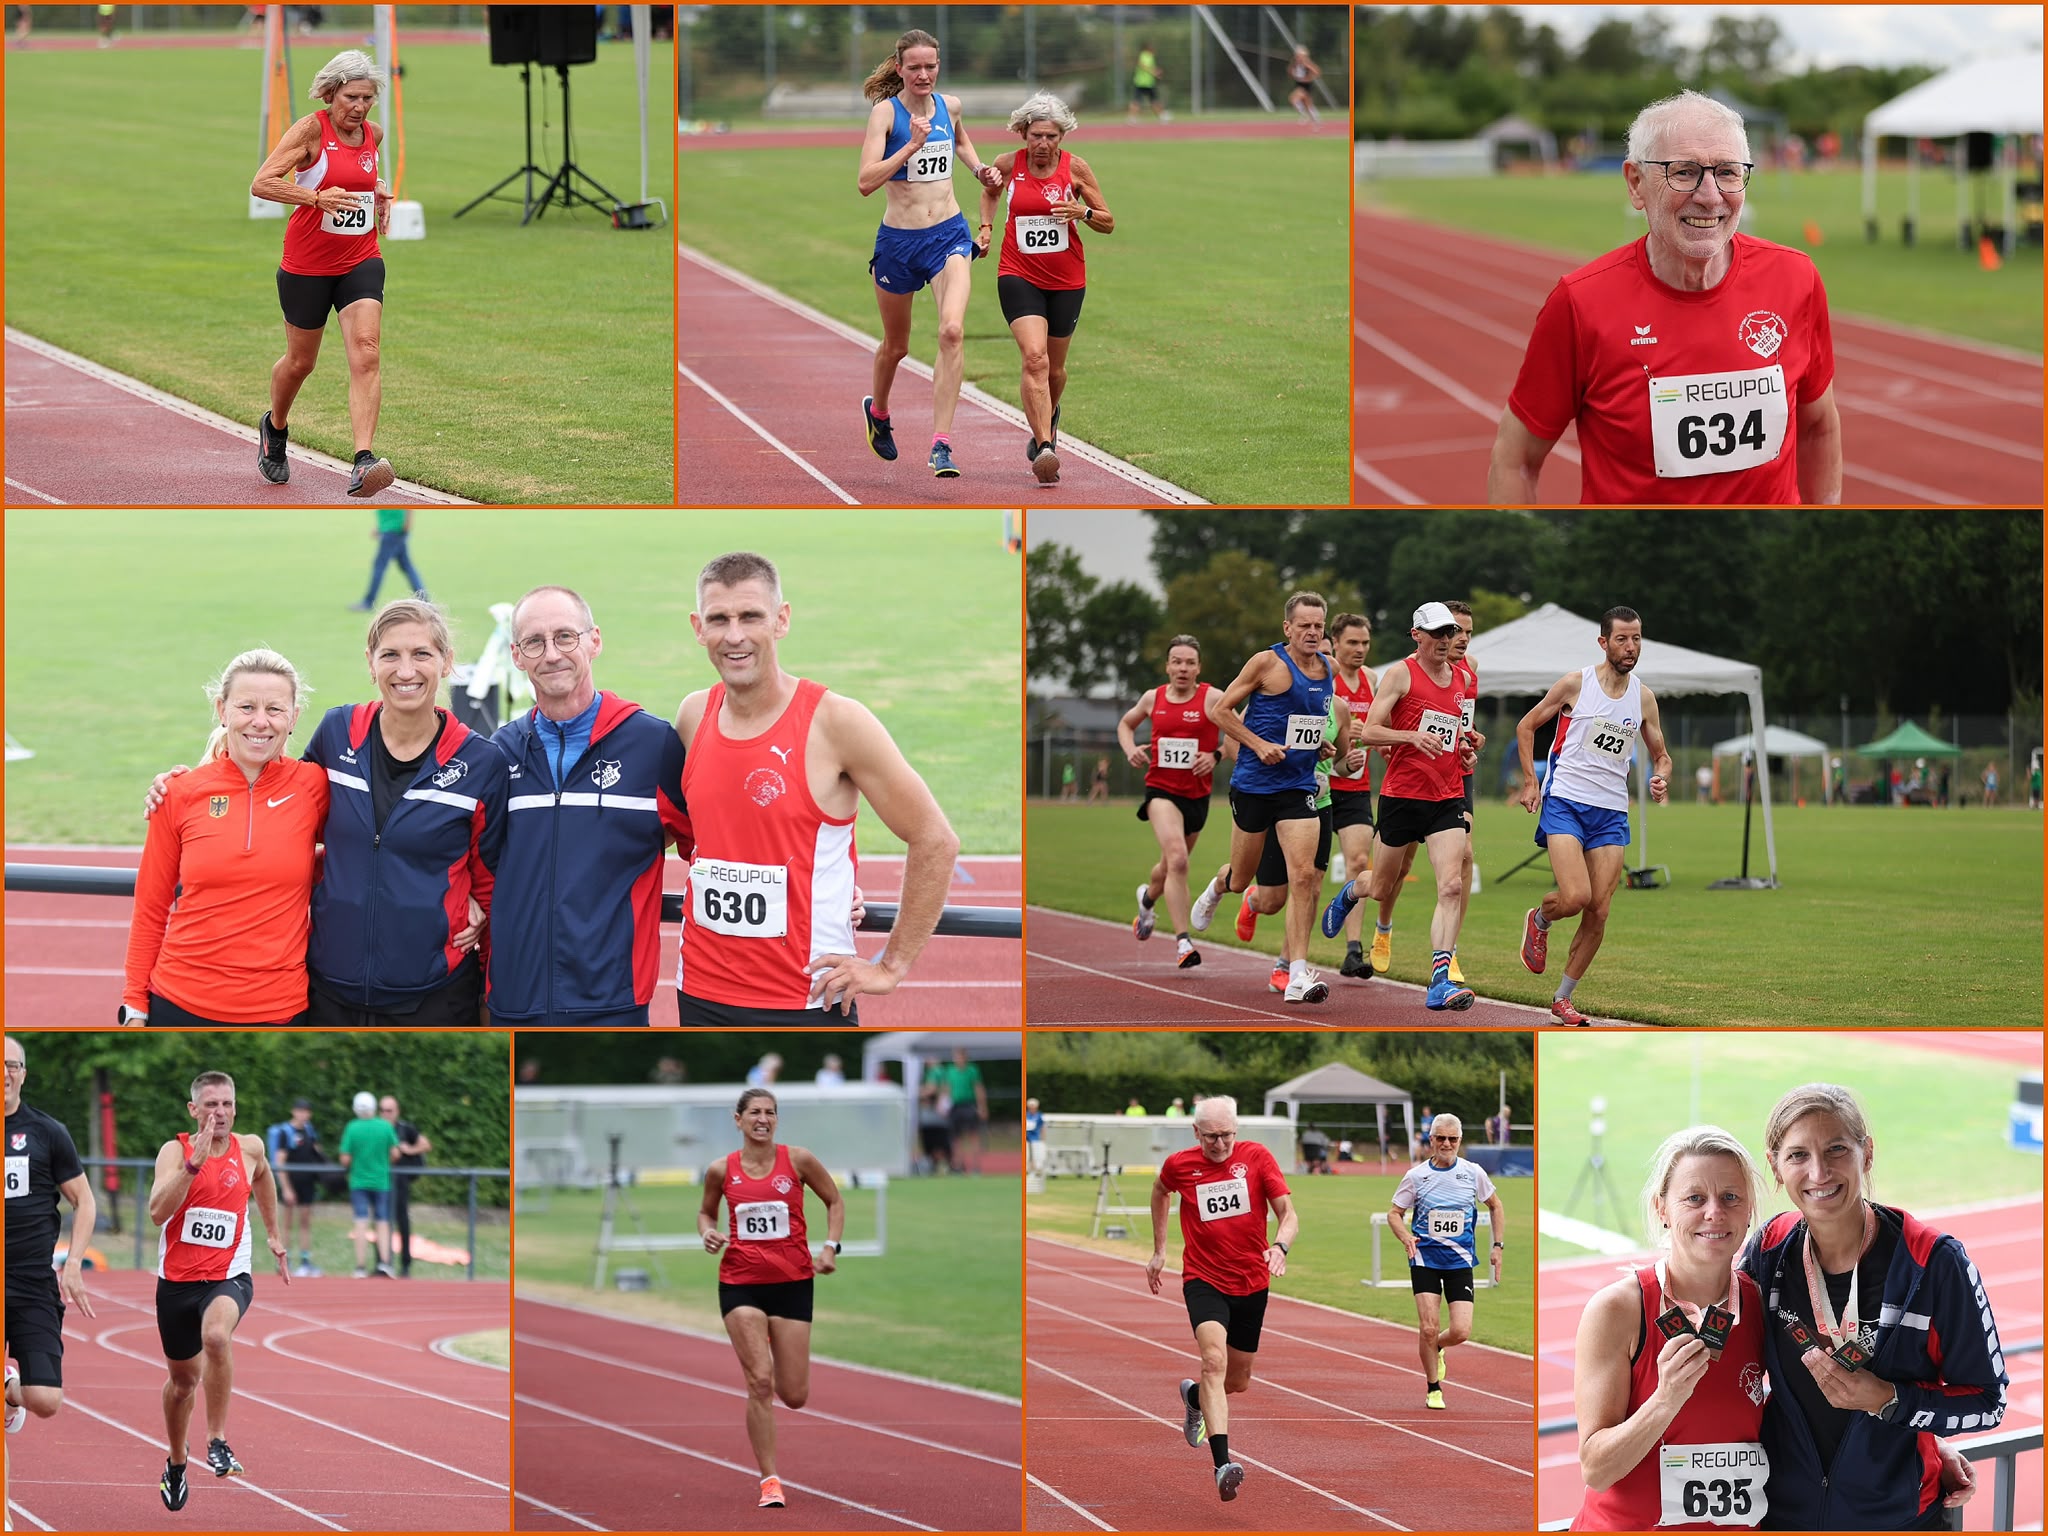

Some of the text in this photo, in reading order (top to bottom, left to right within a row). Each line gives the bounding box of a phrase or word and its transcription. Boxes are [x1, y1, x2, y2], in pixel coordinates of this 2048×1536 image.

[922, 143, 952, 154] REGUPOL
[917, 156, 947, 175] 378
[1025, 229, 1060, 247] 629
[1630, 337, 1658, 346] erima
[1758, 331, 1775, 348] OEDT
[1686, 376, 1781, 403] REGUPOL
[1677, 409, 1767, 459] 634
[1295, 729, 1321, 744] 703
[1603, 722, 1634, 738] REGUPOL
[1593, 733, 1625, 754] 423
[1164, 750, 1190, 764] 512
[710, 865, 782, 885] REGUPOL
[704, 888, 766, 925] 630
[1208, 1182, 1246, 1194] REGUPOL
[1207, 1194, 1241, 1214] 634
[191, 1222, 226, 1241] 630
[746, 1216, 777, 1233] 631
[1434, 1221, 1458, 1232] 546
[1692, 1450, 1766, 1469] REGUPOL
[1683, 1478, 1753, 1517] 635
